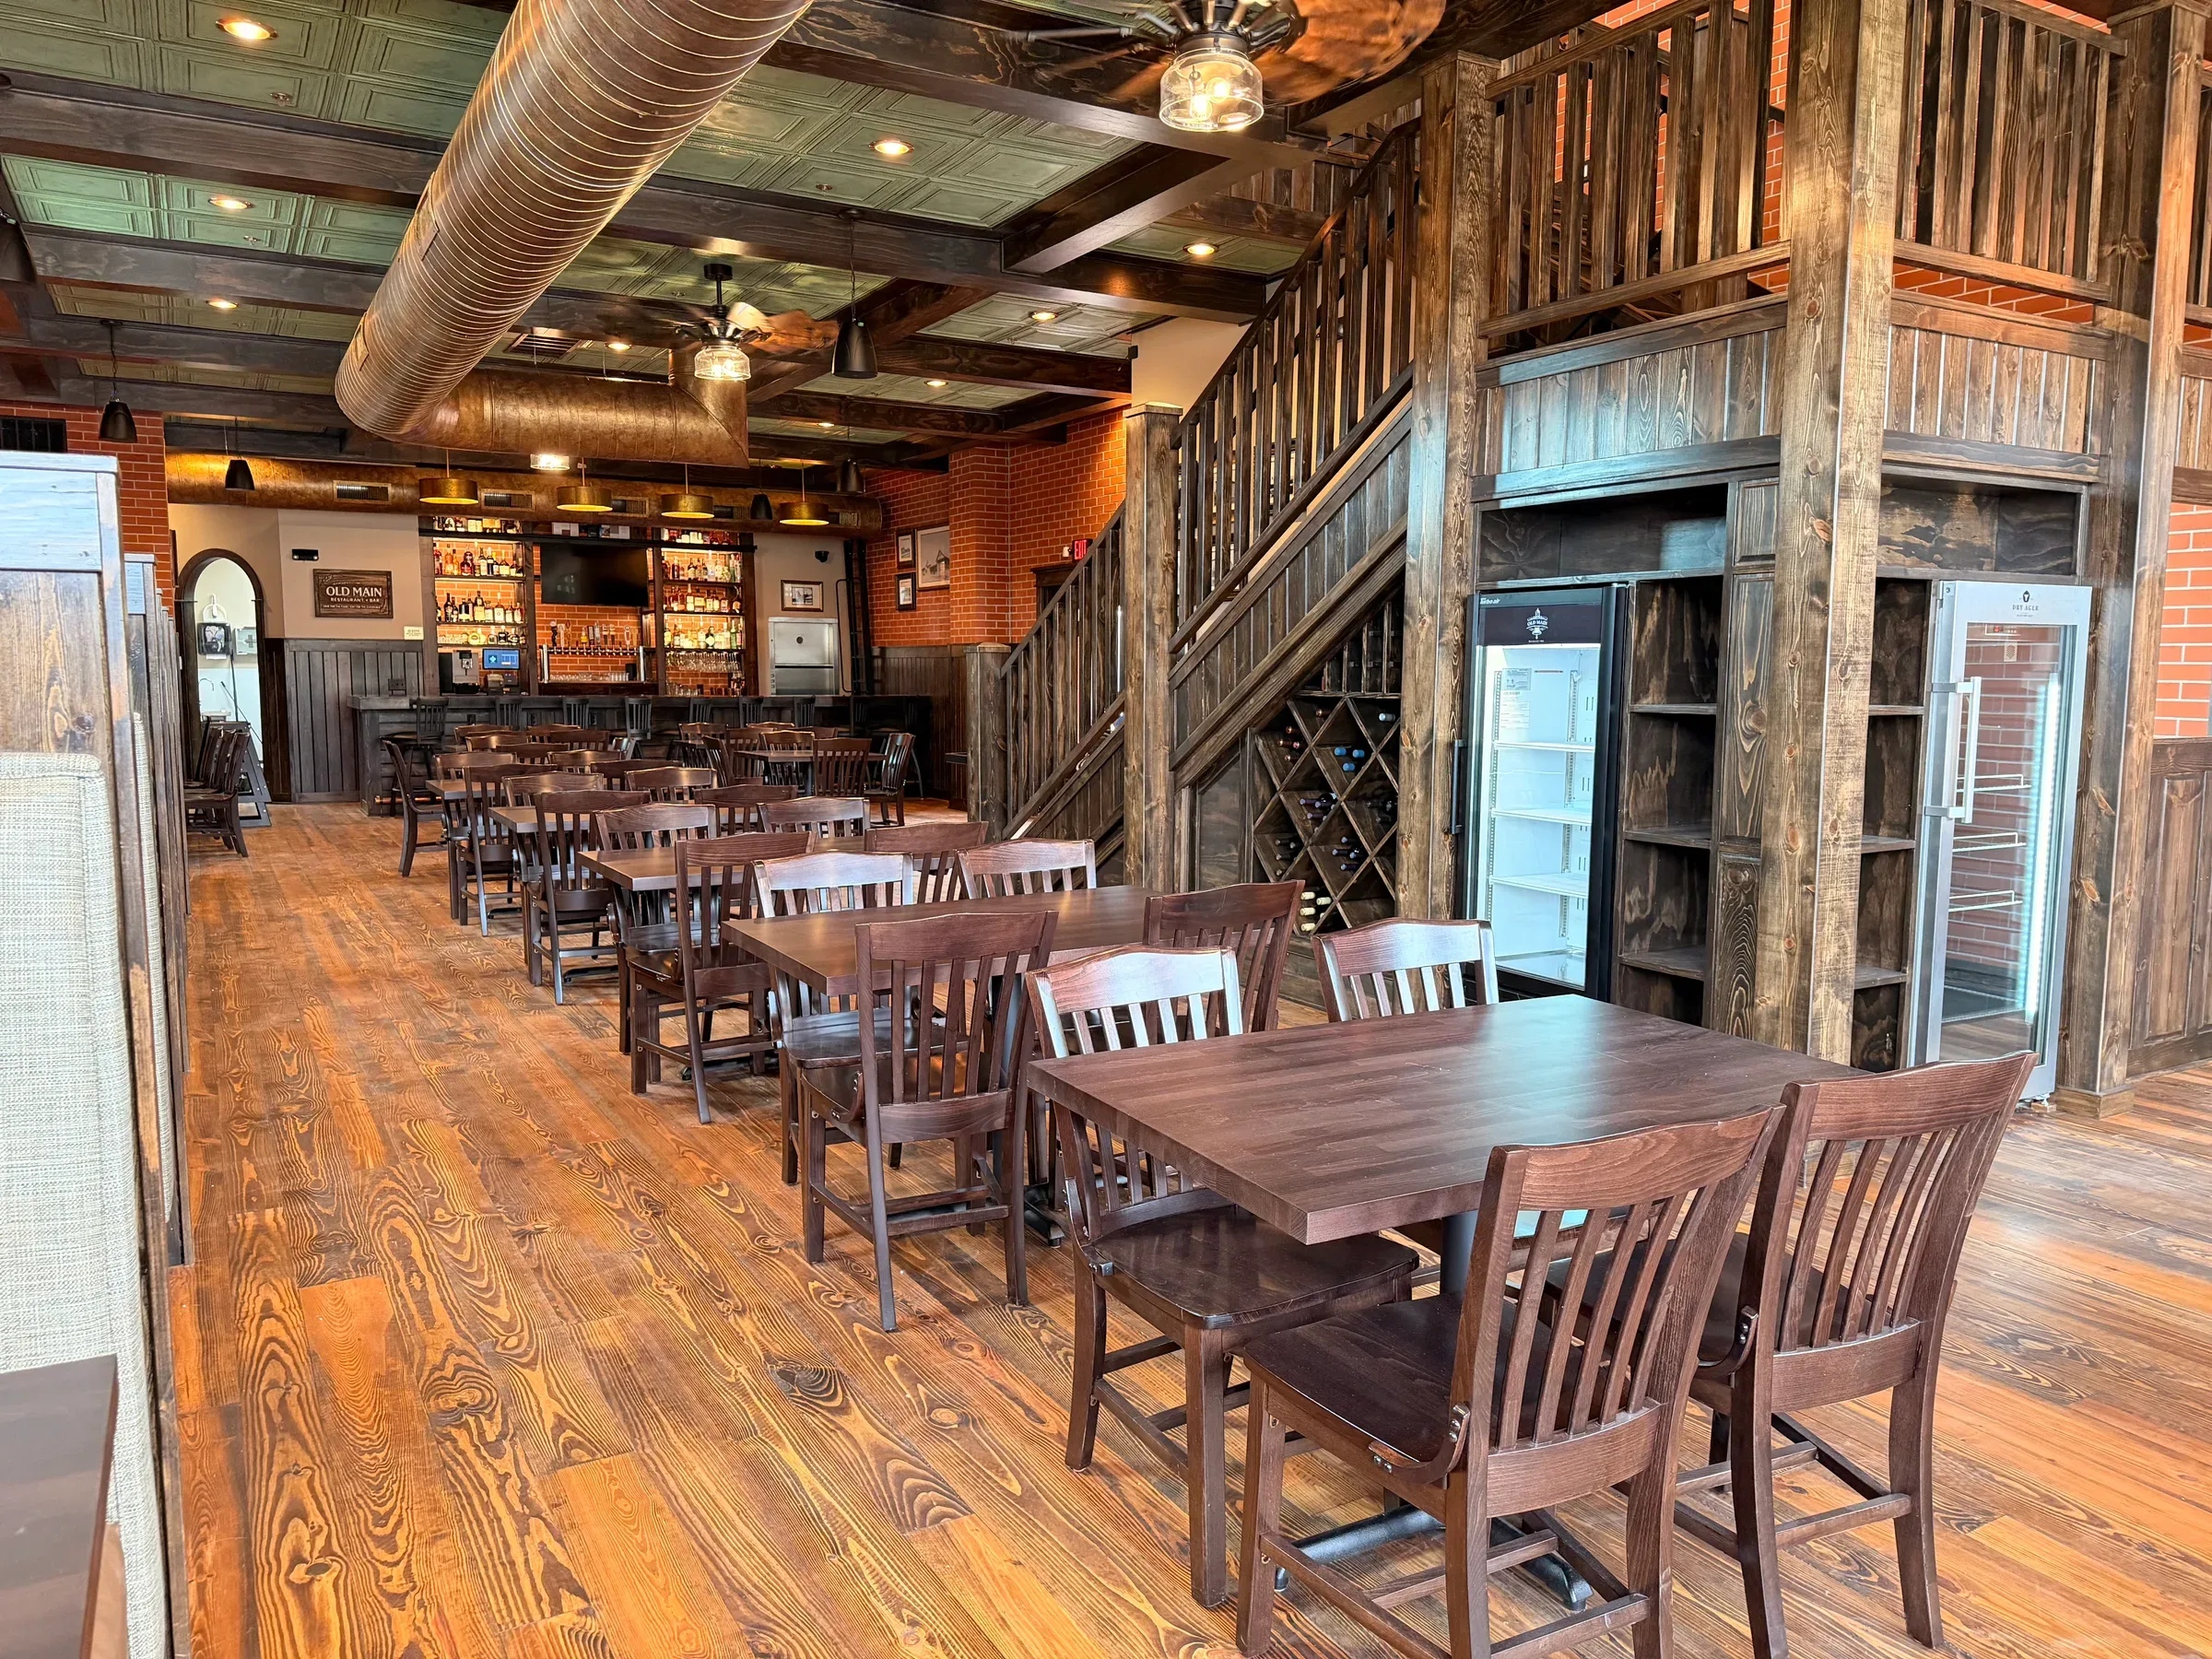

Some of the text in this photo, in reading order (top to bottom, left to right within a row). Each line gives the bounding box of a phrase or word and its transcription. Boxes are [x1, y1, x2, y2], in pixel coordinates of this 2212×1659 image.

[1075, 539, 1087, 559] EXIT
[325, 586, 382, 597] OLD MAIN
